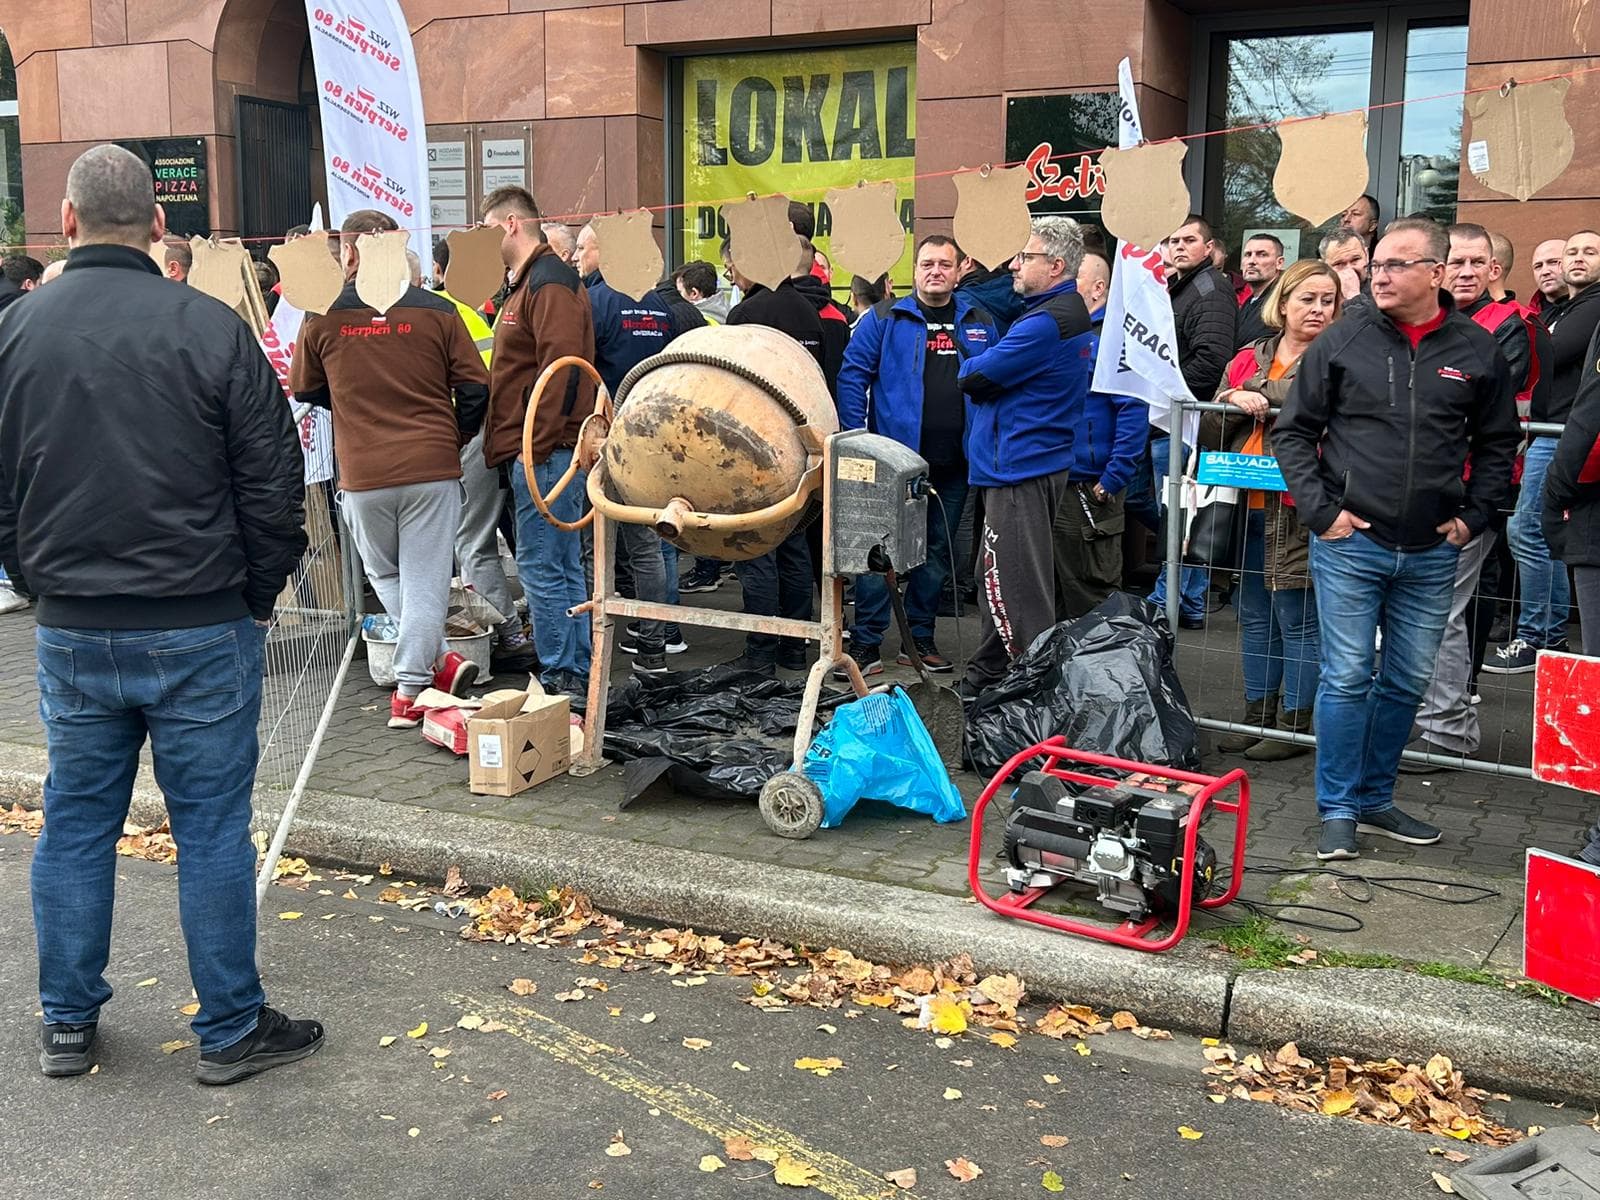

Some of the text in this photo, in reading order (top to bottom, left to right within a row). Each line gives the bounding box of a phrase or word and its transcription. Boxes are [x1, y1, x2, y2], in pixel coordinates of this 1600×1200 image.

[697, 66, 915, 167] LOKAL
[155, 167, 198, 178] VERACE
[155, 180, 198, 192] PIZZA
[397, 323, 412, 335] 80
[52, 1032, 84, 1044] PUMA
